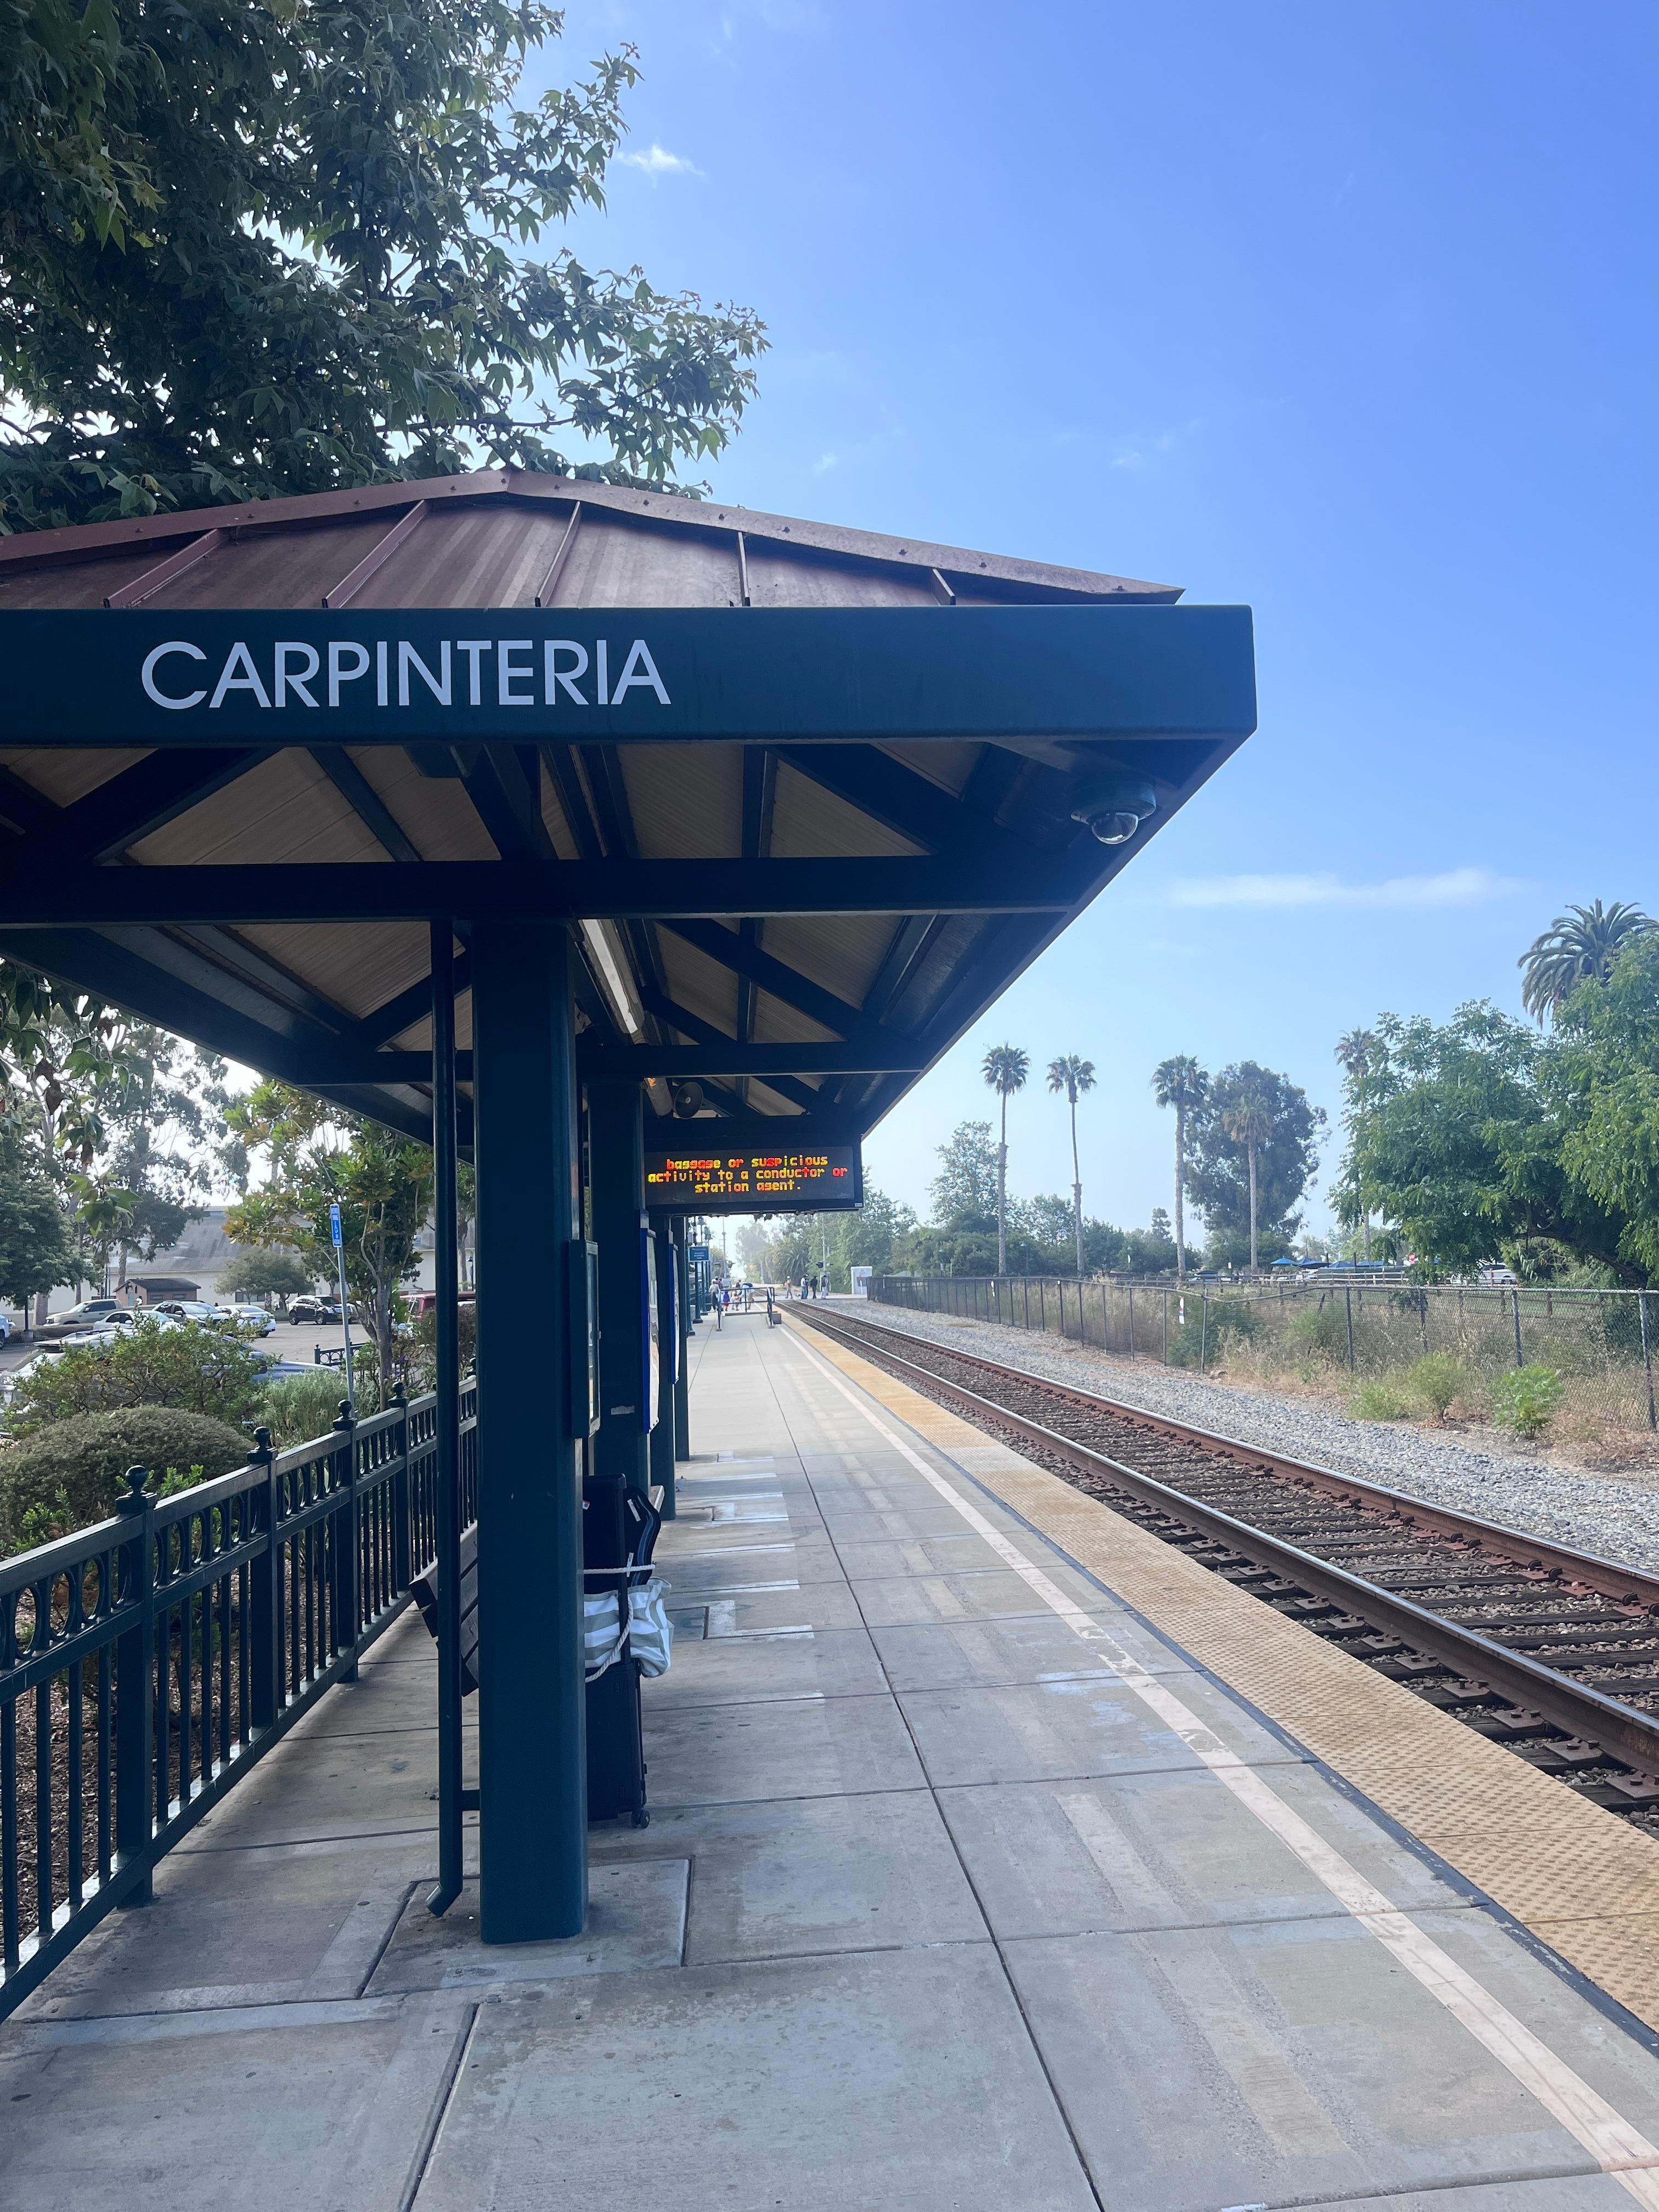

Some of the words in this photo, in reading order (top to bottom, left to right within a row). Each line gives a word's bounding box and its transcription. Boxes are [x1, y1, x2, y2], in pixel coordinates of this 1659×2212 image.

[141, 639, 672, 709] CARPINTERIA
[666, 1159, 721, 1170] baggage
[728, 1159, 744, 1168] or
[751, 1155, 828, 1167] suspicious
[648, 1170, 710, 1183] activity
[718, 1169, 733, 1180] to
[741, 1171, 749, 1180] a
[756, 1167, 825, 1179] conductor
[832, 1167, 848, 1177] or
[695, 1181, 749, 1193] station
[757, 1179, 801, 1192] agent.
